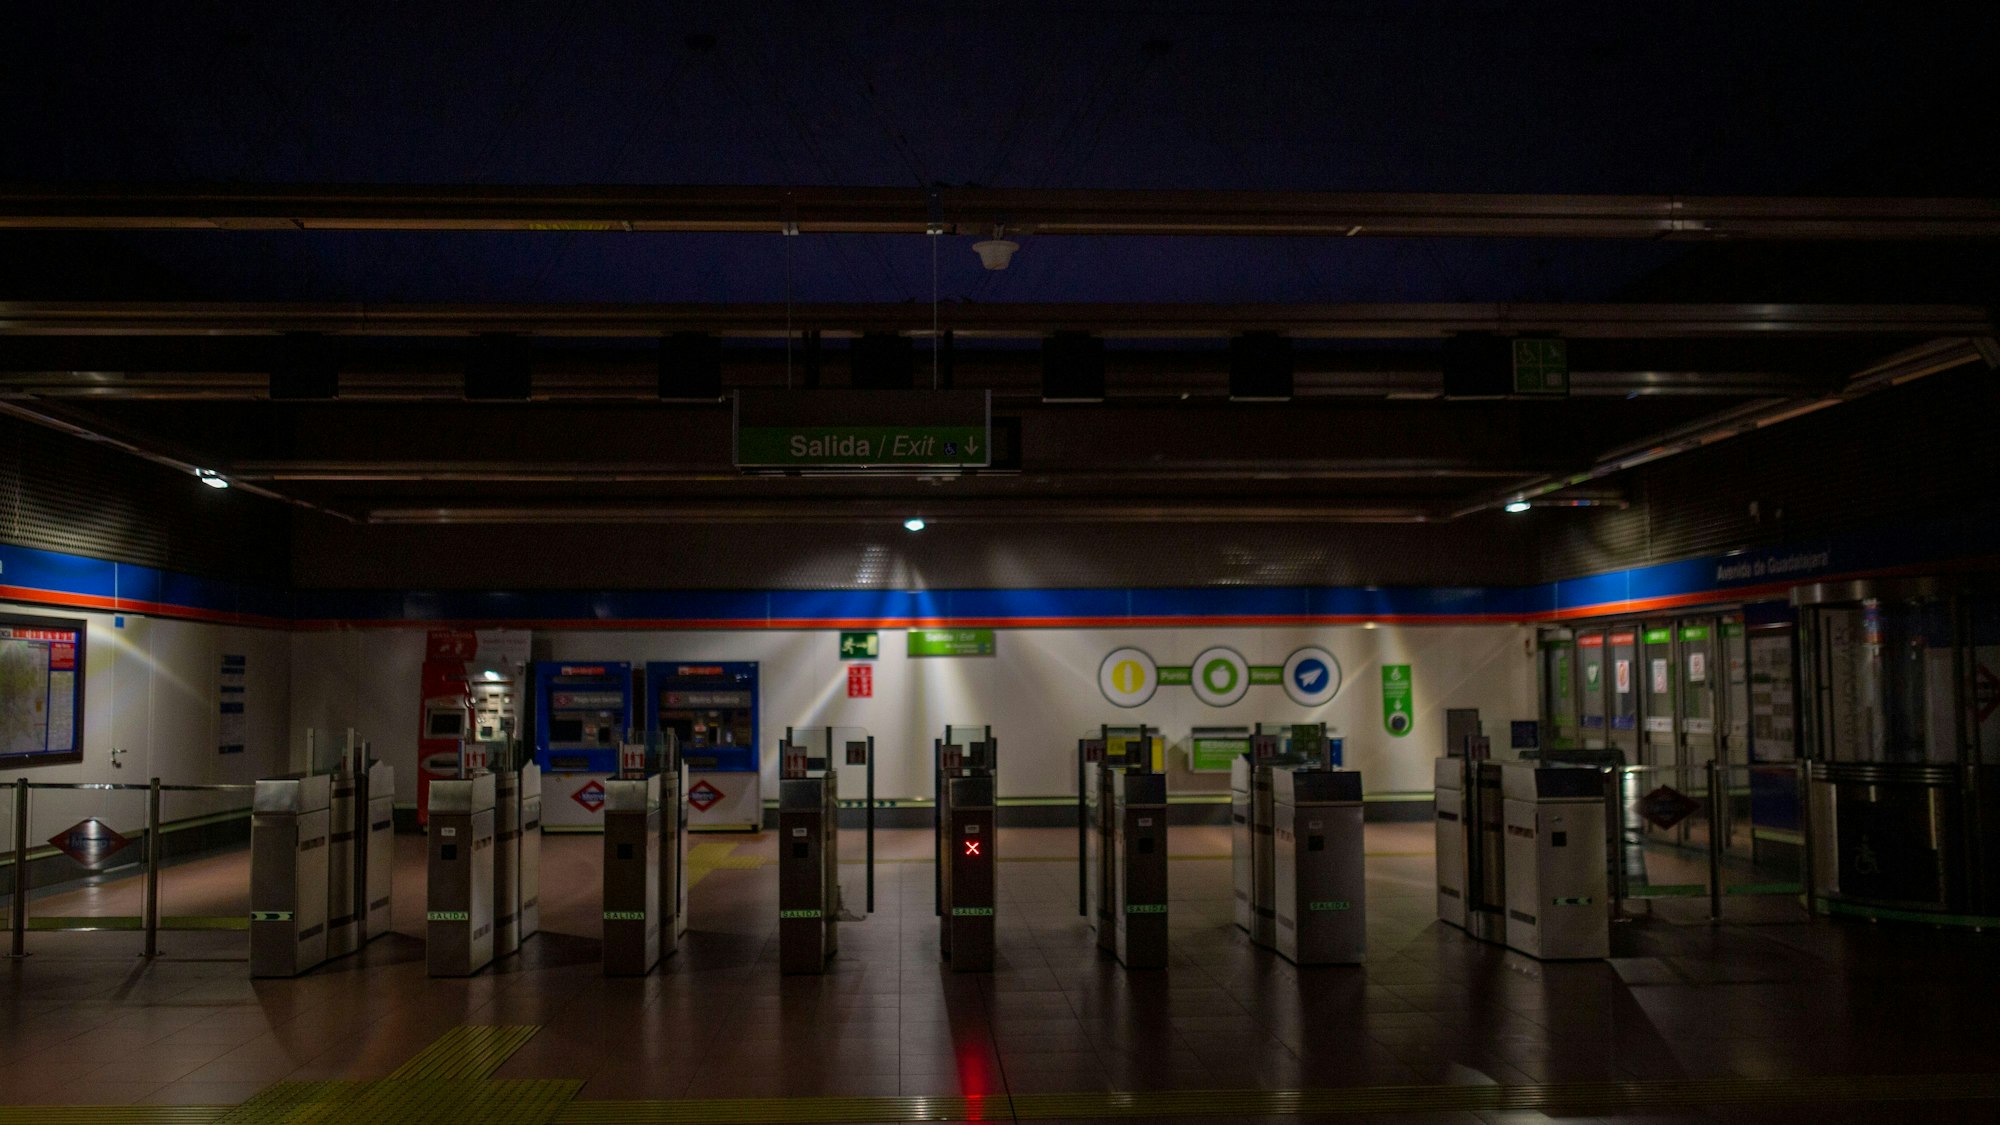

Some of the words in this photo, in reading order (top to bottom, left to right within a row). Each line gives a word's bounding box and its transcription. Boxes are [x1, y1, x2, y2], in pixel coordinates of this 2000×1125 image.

[789, 434, 871, 457] Salida
[876, 435, 887, 459] /
[892, 435, 936, 457] Exit
[1311, 902, 1348, 910] SALIDA
[429, 912, 467, 920] SALIDA
[605, 912, 644, 920] SALIDA
